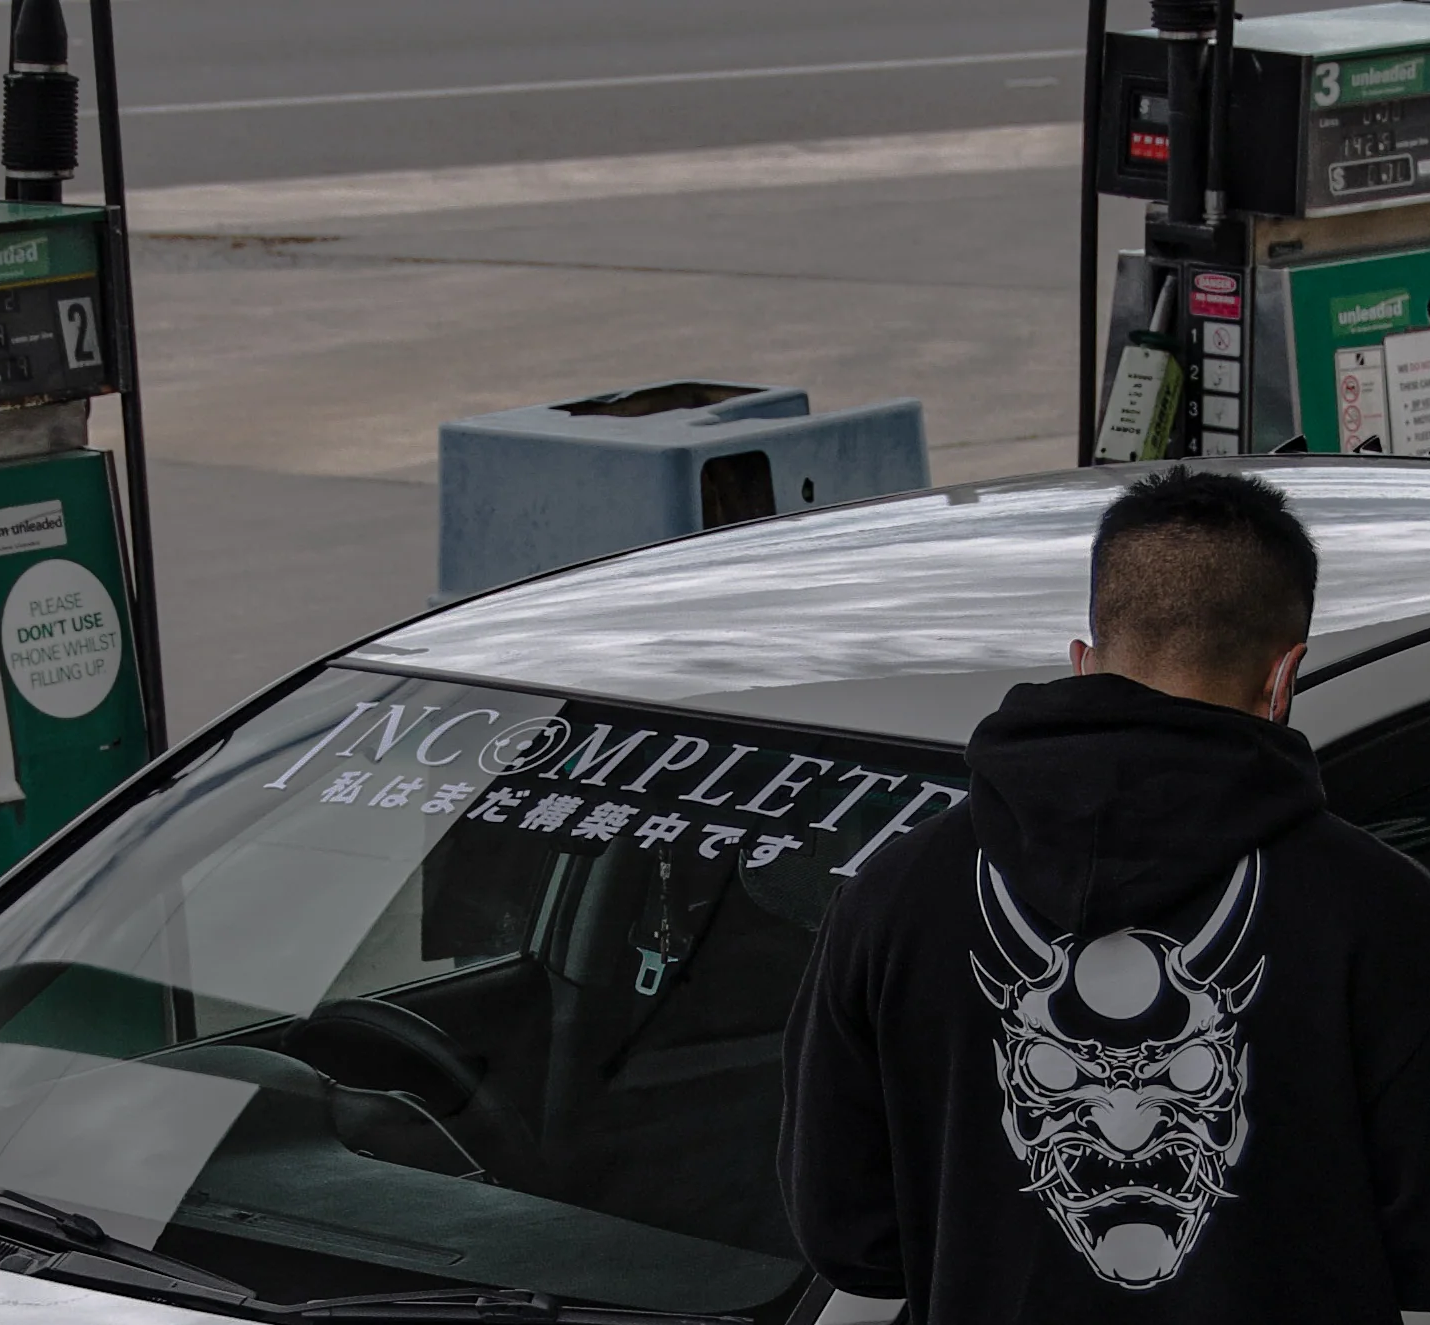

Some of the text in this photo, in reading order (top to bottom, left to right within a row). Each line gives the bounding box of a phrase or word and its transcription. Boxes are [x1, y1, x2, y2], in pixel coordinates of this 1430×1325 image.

[1314, 61, 1341, 107] 3
[1351, 62, 1416, 87] unleaded
[1338, 300, 1404, 325] unleaded
[68, 303, 95, 362] 2
[1191, 329, 1197, 343] 1
[1190, 366, 1199, 380] 2
[1189, 402, 1198, 416] 3
[1111, 425, 1141, 435] SORRY
[1189, 438, 1197, 451] 4
[11, 516, 62, 535] unleaded
[29, 592, 84, 617] PLEASE
[17, 612, 104, 643] DON'T USE
[11, 632, 117, 669] PHONE WHILST
[30, 663, 82, 690] FILLING
[320, 769, 803, 868] 私はまだ構築中です
